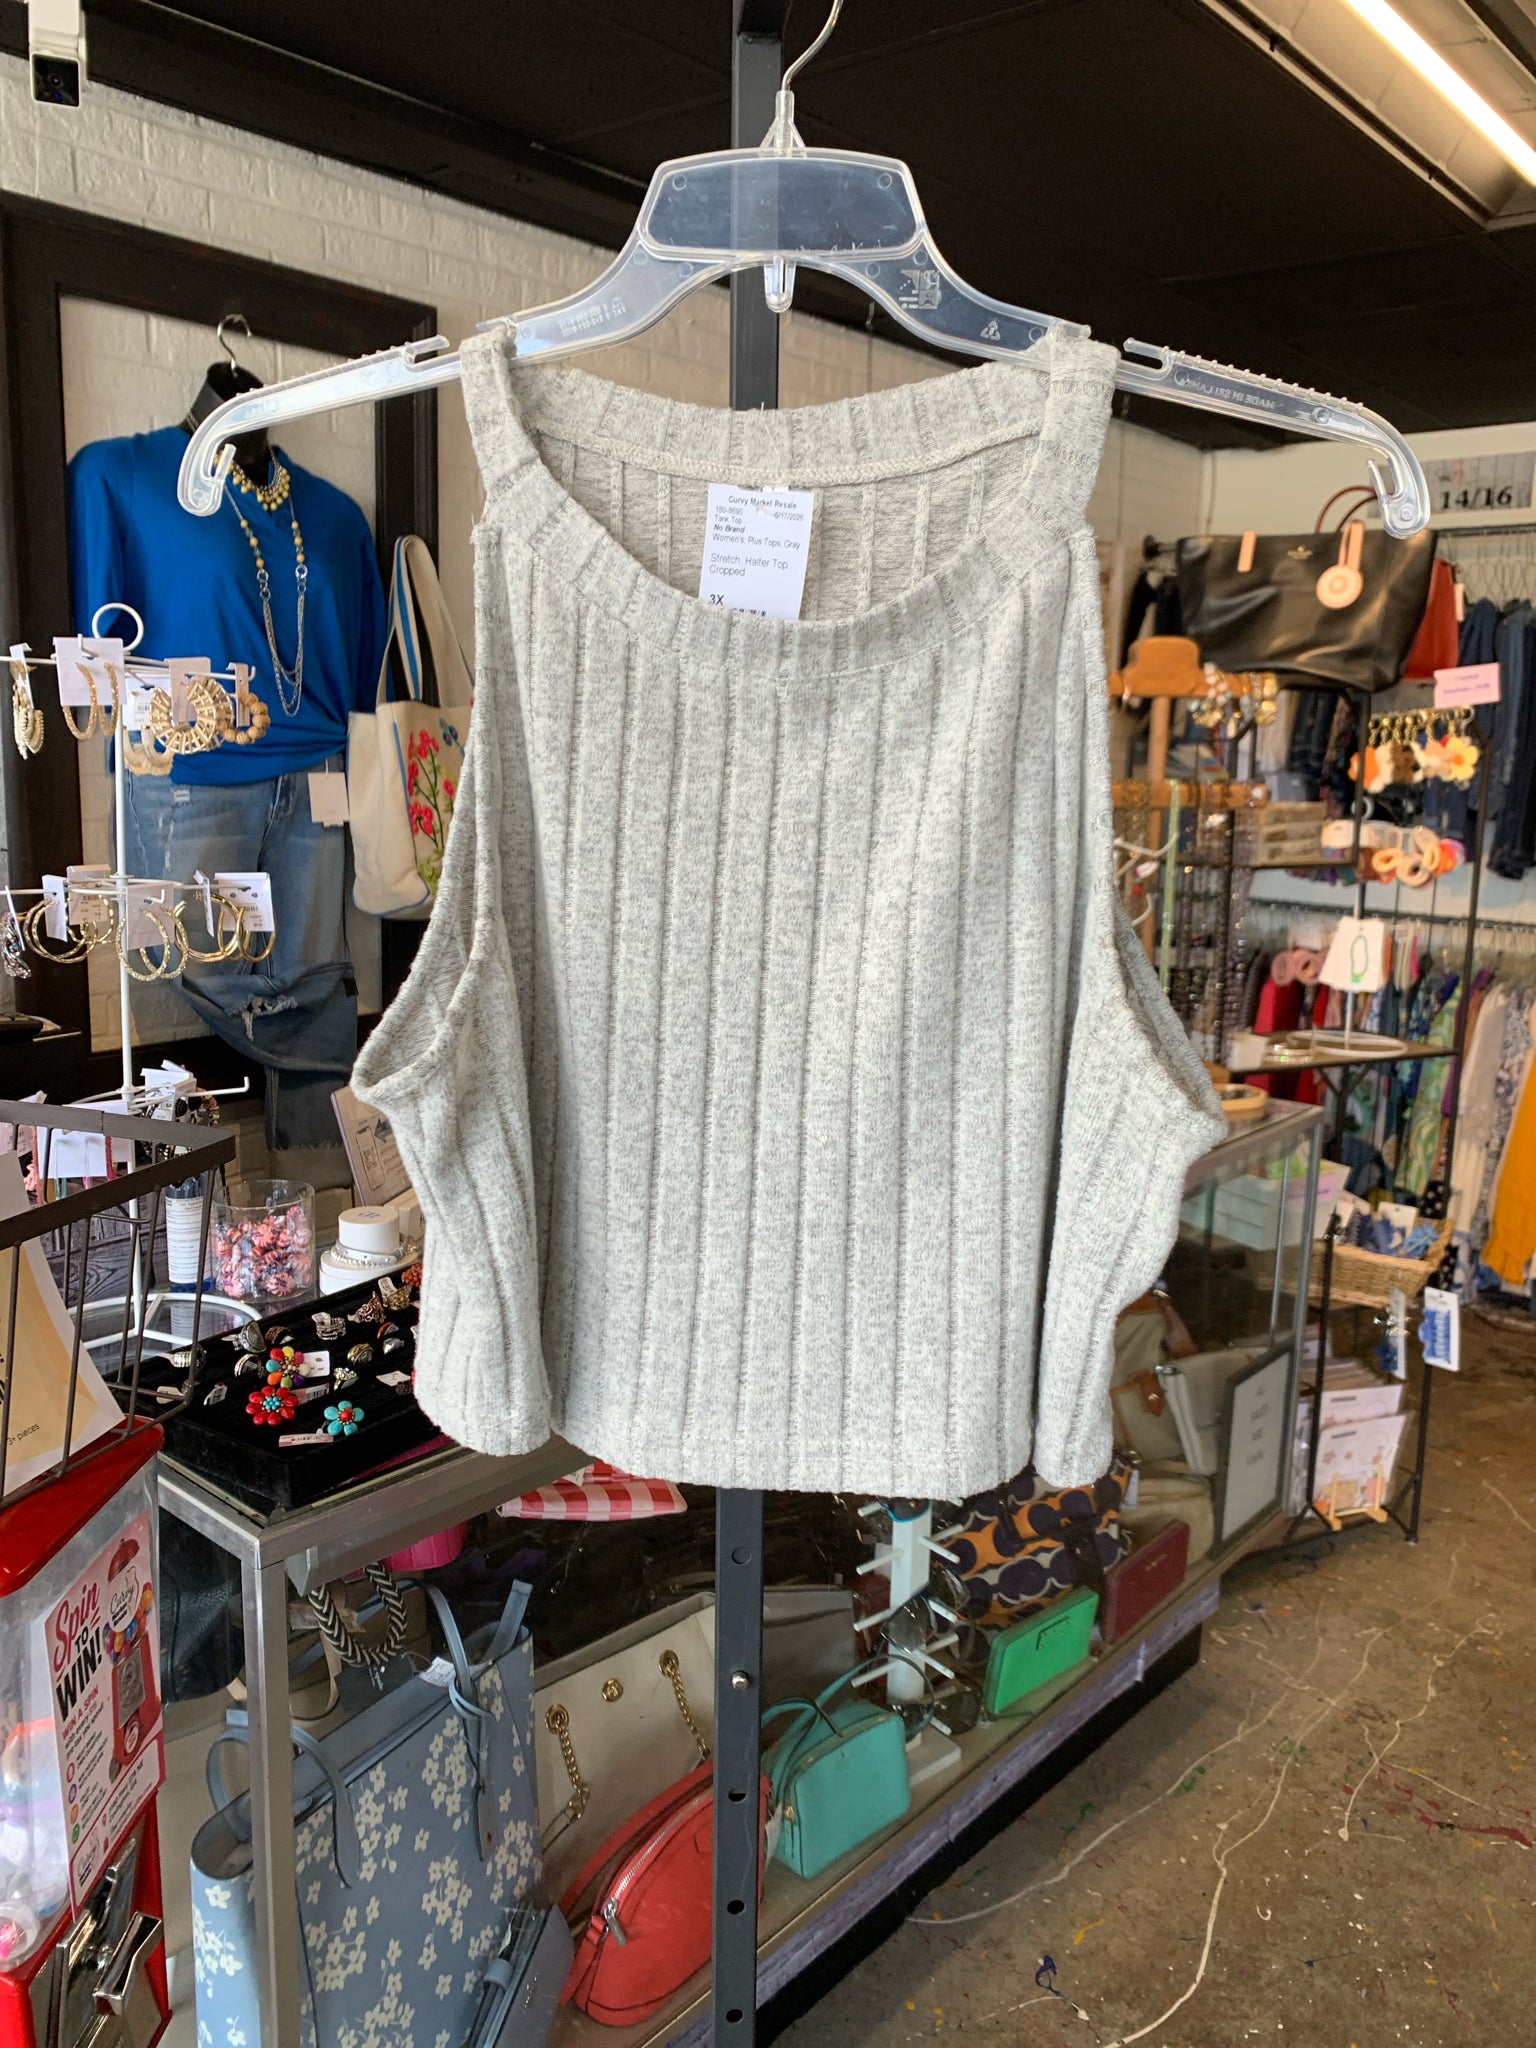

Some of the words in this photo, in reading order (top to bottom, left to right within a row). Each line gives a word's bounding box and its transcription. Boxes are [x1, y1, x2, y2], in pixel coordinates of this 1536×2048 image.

[728, 495, 748, 505] Curvy
[750, 498, 773, 507] Market
[774, 500, 797, 509] Resale
[1442, 486, 1513, 510] 14/16
[731, 516, 743, 525] Top
[713, 524, 723, 532] No
[725, 525, 746, 534] Brand
[747, 536, 762, 545] Plus
[784, 540, 801, 550] Gray
[709, 564, 746, 577] Cropped
[745, 556, 770, 567] Halter
[773, 559, 789, 571] Top
[709, 594, 725, 606] 3X
[17, 1423, 40, 1441] pieces
[53, 1582, 100, 1671] Spin
[75, 1626, 89, 1653] TO
[56, 1627, 102, 1722] WIN!
[62, 1714, 77, 1741] WIN
[84, 1685, 99, 1712] SPIN
